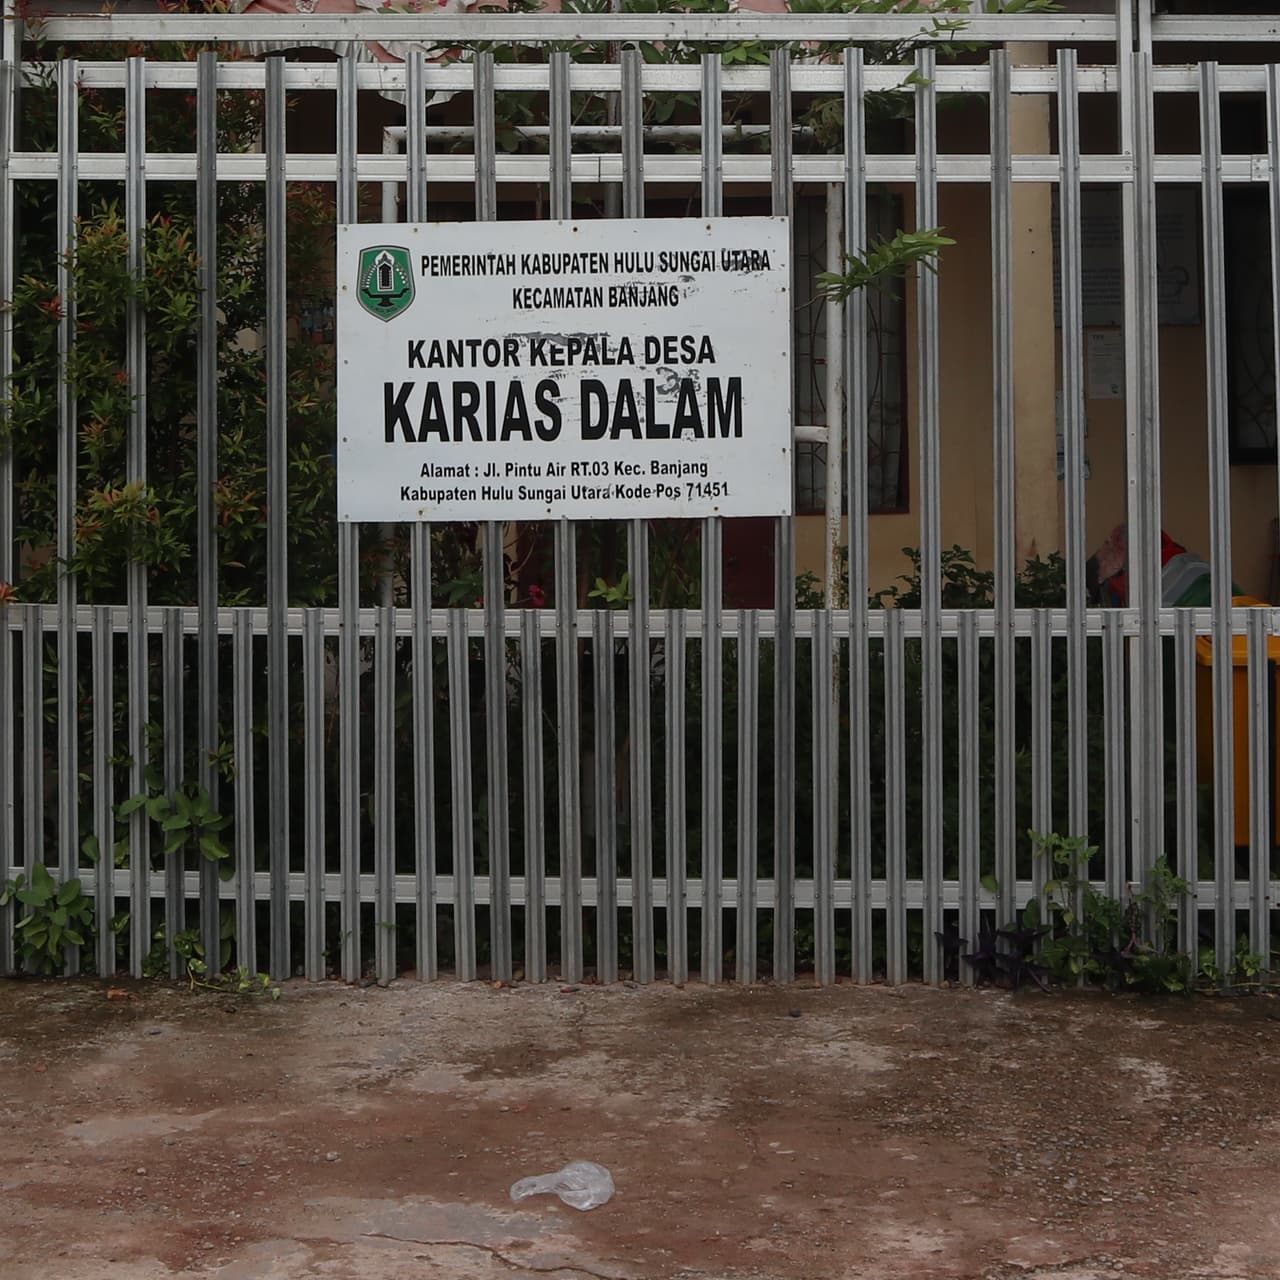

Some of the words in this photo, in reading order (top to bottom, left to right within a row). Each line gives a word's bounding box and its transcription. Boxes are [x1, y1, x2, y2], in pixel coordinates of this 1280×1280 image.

[420, 254, 516, 277] PEMERINTAH
[520, 252, 609, 275] KABUPATEN
[614, 251, 655, 273] HULU
[659, 251, 717, 272] SUNGAI
[720, 249, 772, 272] UTARA
[512, 287, 604, 309] KECAMATAN
[608, 285, 680, 308] BANJANG
[407, 338, 521, 369] KANTOR
[529, 336, 635, 367] KEPALA
[644, 335, 716, 365] DESA
[383, 378, 563, 443] KARIAS
[580, 376, 744, 440] DALAM
[420, 462, 470, 478] Alamat
[483, 462, 500, 477] Jl.
[505, 462, 541, 477] Pintu
[546, 462, 566, 477] Air
[571, 461, 609, 476] RT.03
[614, 460, 646, 476] Kec.
[650, 459, 708, 477] Banjang
[400, 485, 476, 504] Kabupaten
[481, 485, 514, 501] Hulu
[518, 485, 566, 503] Sungai
[571, 484, 610, 500] Utara
[615, 483, 651, 499] Kode
[656, 483, 681, 498] Pos
[686, 482, 729, 499] 71451
